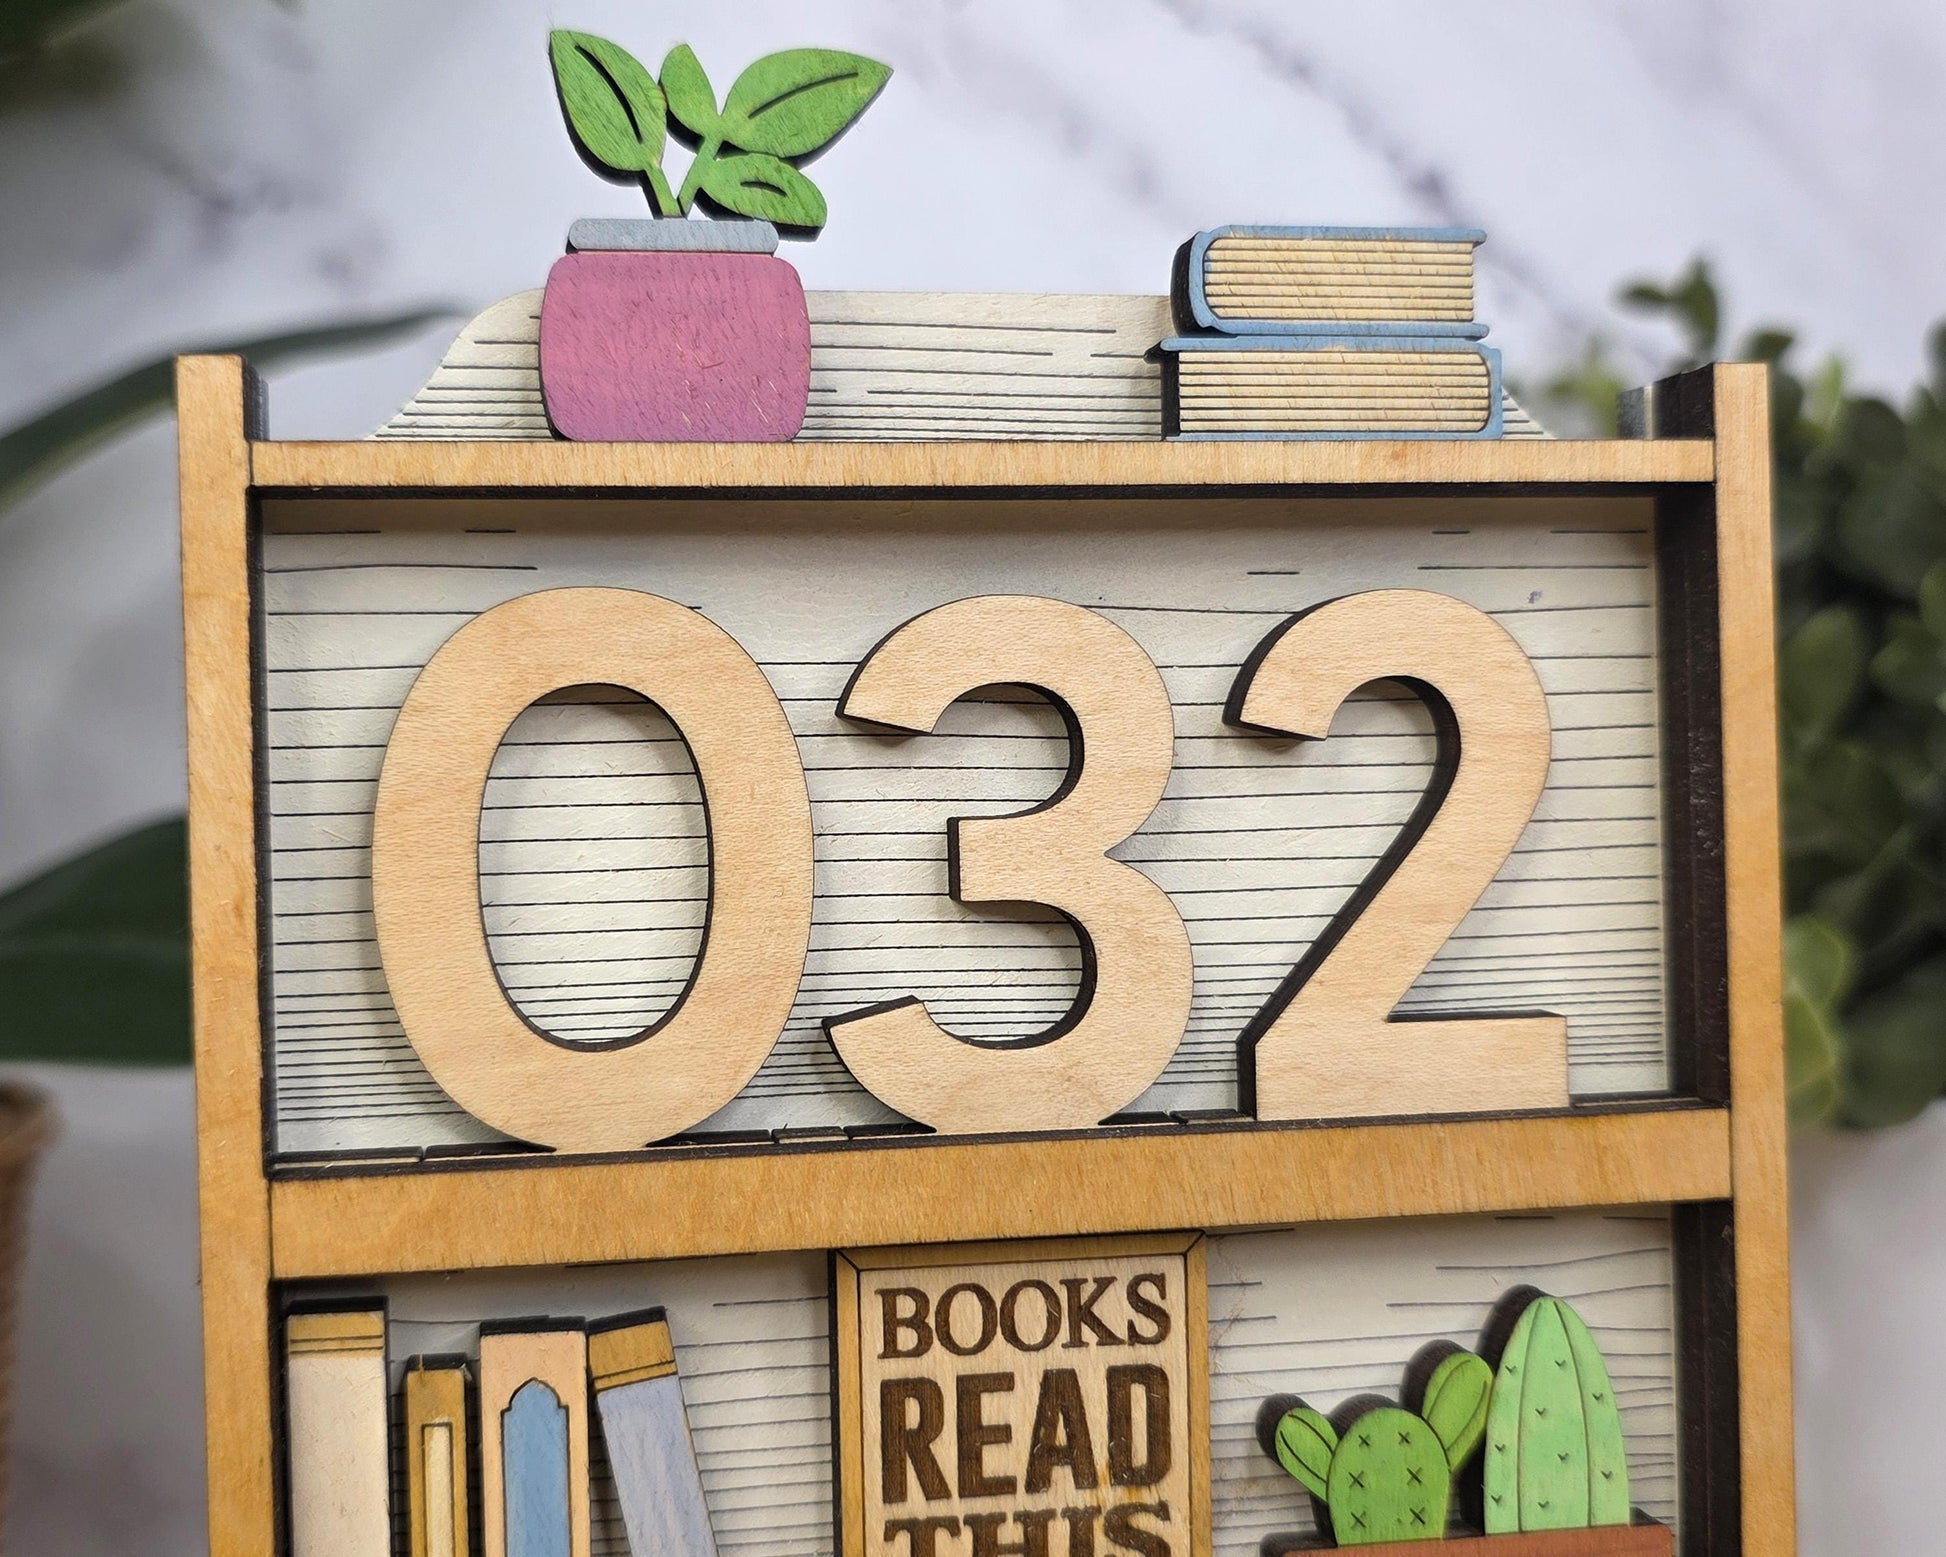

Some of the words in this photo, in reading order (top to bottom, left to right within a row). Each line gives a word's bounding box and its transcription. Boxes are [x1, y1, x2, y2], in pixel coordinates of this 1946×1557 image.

[371, 586, 1570, 1153] 032
[874, 1272, 1172, 1359] BOOKS
[880, 1363, 1172, 1504] READ
[883, 1500, 1172, 1557] THIS
